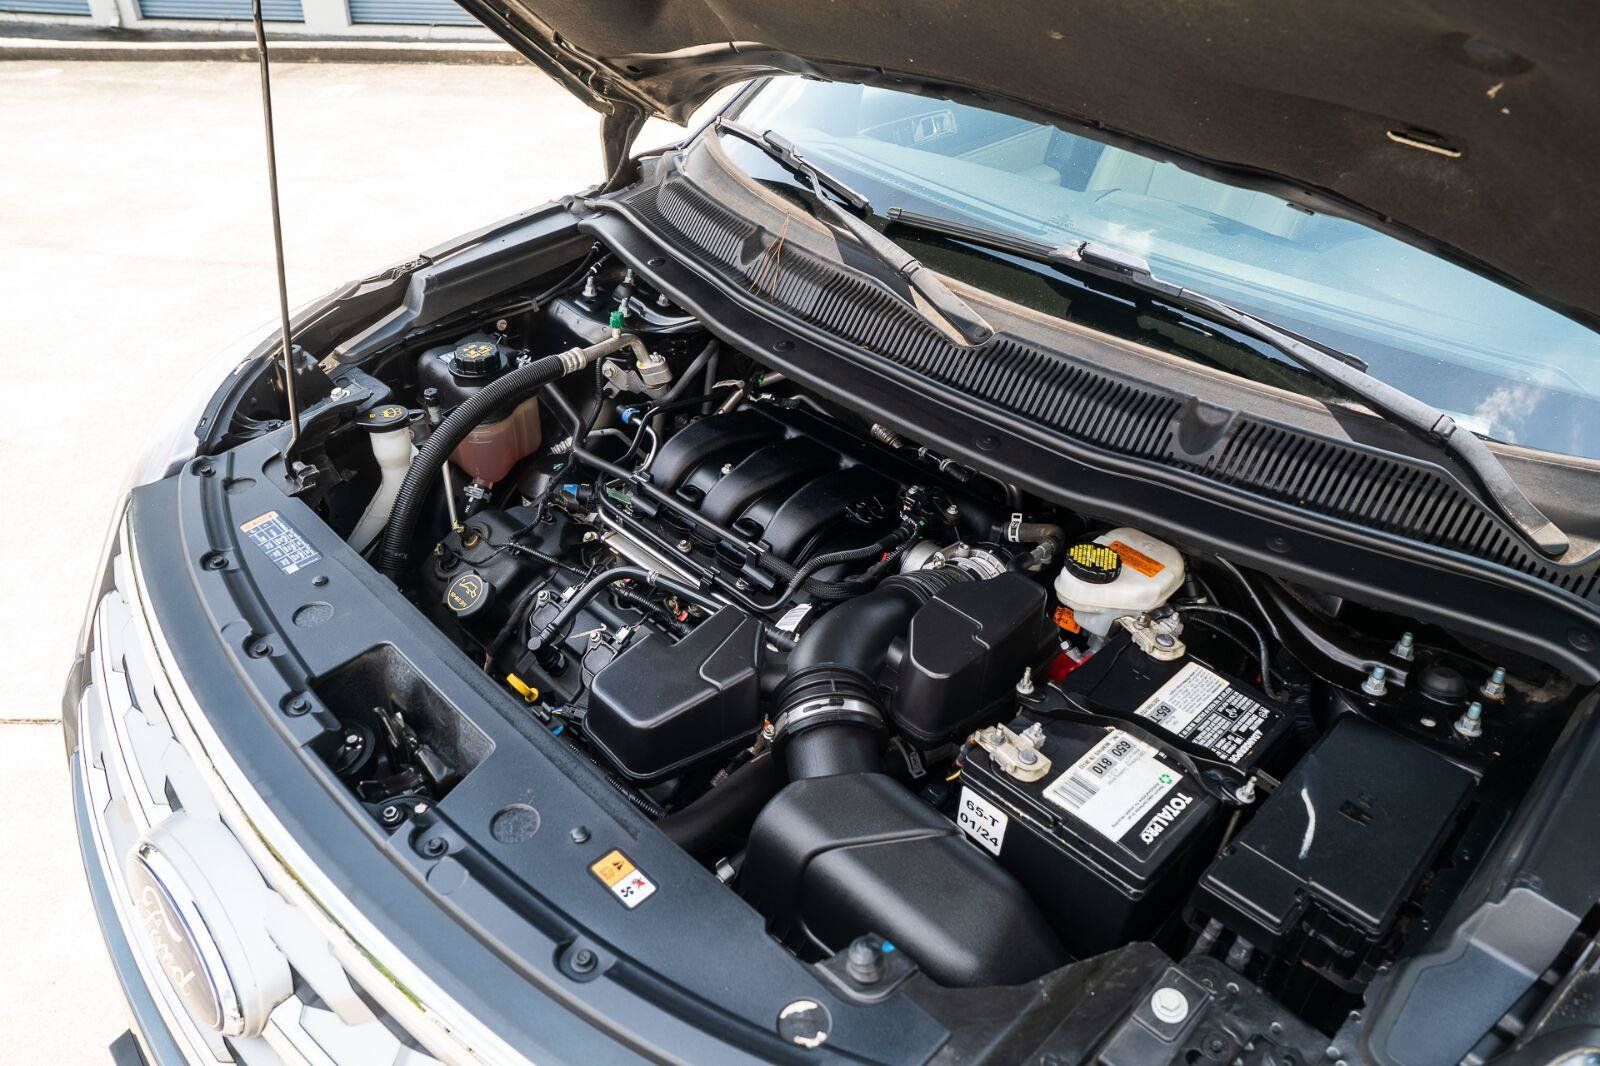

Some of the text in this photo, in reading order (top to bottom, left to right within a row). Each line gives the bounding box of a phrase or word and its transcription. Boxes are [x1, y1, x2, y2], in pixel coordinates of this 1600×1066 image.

[1147, 703, 1172, 724] 65-T
[1109, 739, 1132, 758] 650
[1090, 756, 1113, 775] 810
[966, 800, 999, 827] 65-T
[1138, 791, 1194, 845] TOTALPRO
[960, 812, 999, 847] 01/24
